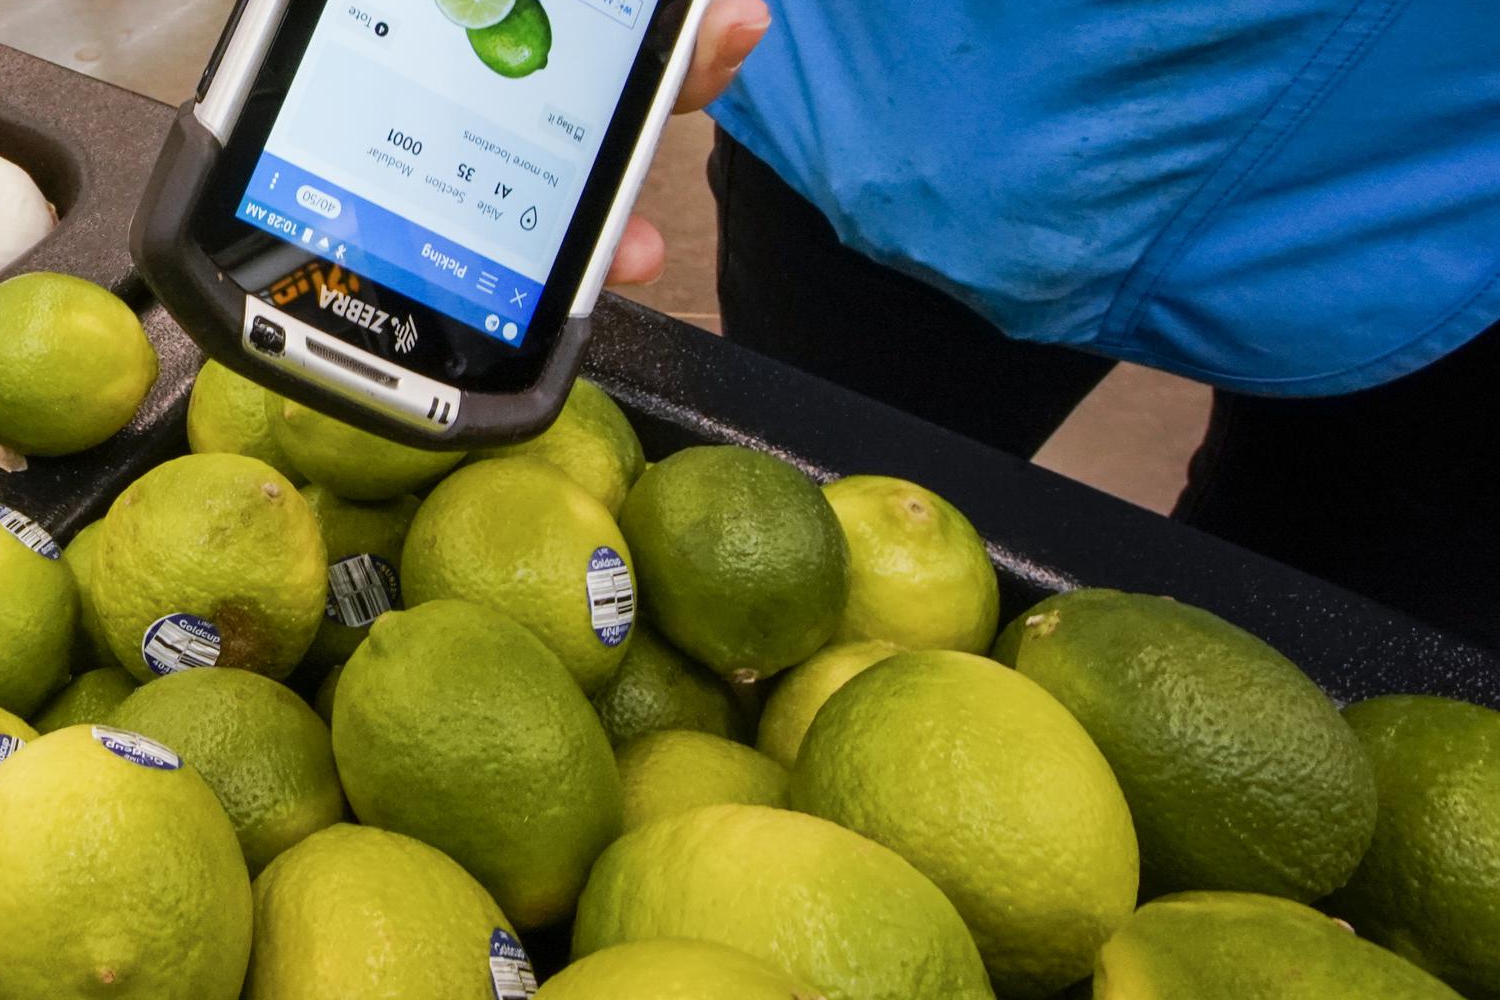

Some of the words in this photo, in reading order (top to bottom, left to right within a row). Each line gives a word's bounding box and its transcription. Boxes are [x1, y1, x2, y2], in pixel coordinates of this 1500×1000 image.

[347, 6, 372, 28] Tote
[547, 112, 556, 124] it
[555, 114, 574, 135] Bag
[386, 127, 423, 156] 0001
[463, 129, 511, 163] locations
[367, 146, 414, 177] Modular
[456, 162, 476, 182] 35
[511, 155, 541, 176] more
[424, 174, 466, 204] Section
[493, 181, 513, 199] A1
[541, 170, 559, 188] No
[244, 201, 268, 221] AM
[301, 190, 336, 213] 40/50
[476, 199, 504, 221] Aisle
[266, 211, 297, 236] 10:28
[420, 241, 468, 279] Picking
[317, 283, 390, 333] ZEBRA
[591, 558, 621, 570] Goldcup
[178, 619, 221, 644] Goldcup
